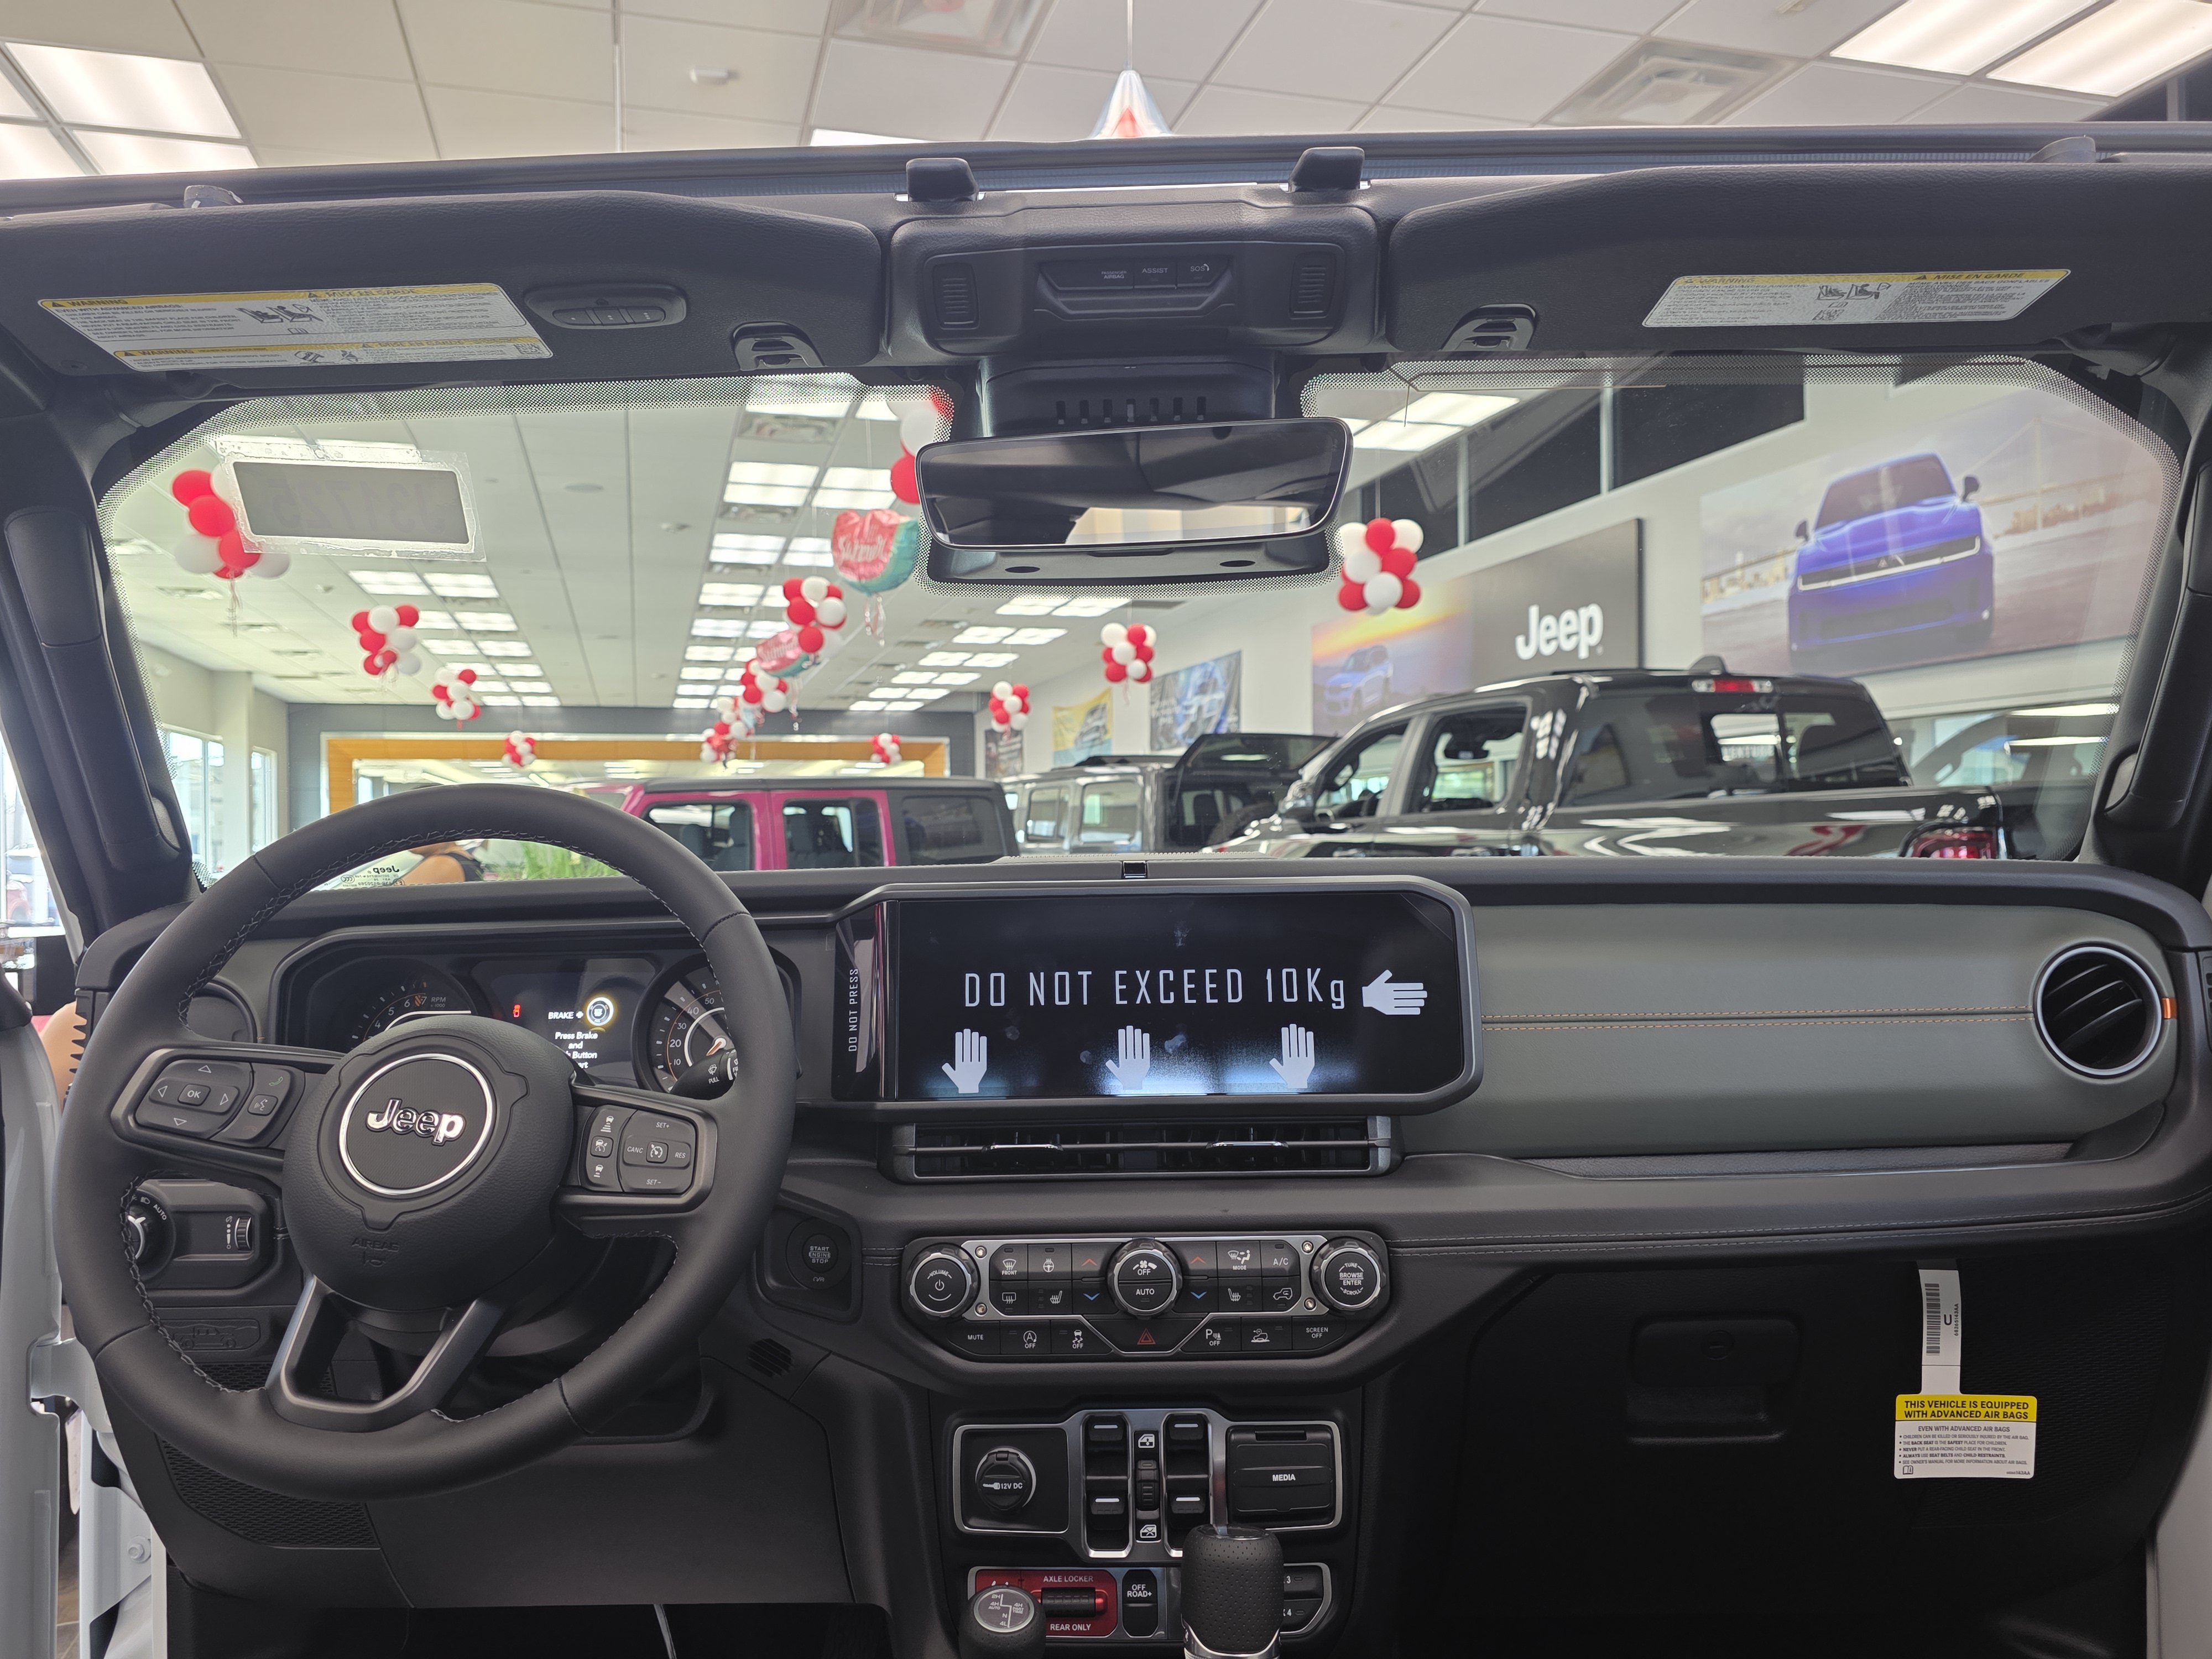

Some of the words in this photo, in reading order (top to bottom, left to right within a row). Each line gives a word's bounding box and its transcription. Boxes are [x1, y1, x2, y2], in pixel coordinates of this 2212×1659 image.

[1515, 603, 1604, 660] Jeep
[849, 968, 858, 1004] PRESS
[964, 972, 1006, 1008] DO
[1030, 971, 1093, 1006] NOT
[1115, 968, 1244, 1005] EXCEED
[1266, 967, 1346, 1009] 10Kg
[404, 999, 410, 1008] 6
[388, 1007, 395, 1015] 5
[374, 1020, 381, 1029] 4
[849, 1010, 857, 1031] NOT
[576, 1031, 598, 1040] Brake
[568, 1041, 583, 1049] and
[670, 1039, 681, 1047] 20
[848, 1037, 857, 1051] DO
[572, 1051, 597, 1059] Button
[187, 1089, 201, 1099] OK
[367, 1098, 465, 1146] Jeep
[153, 1203, 167, 1220] AUTO
[1273, 1257, 1288, 1266] A/C
[1981, 1401, 2028, 1410] EQUIPPED
